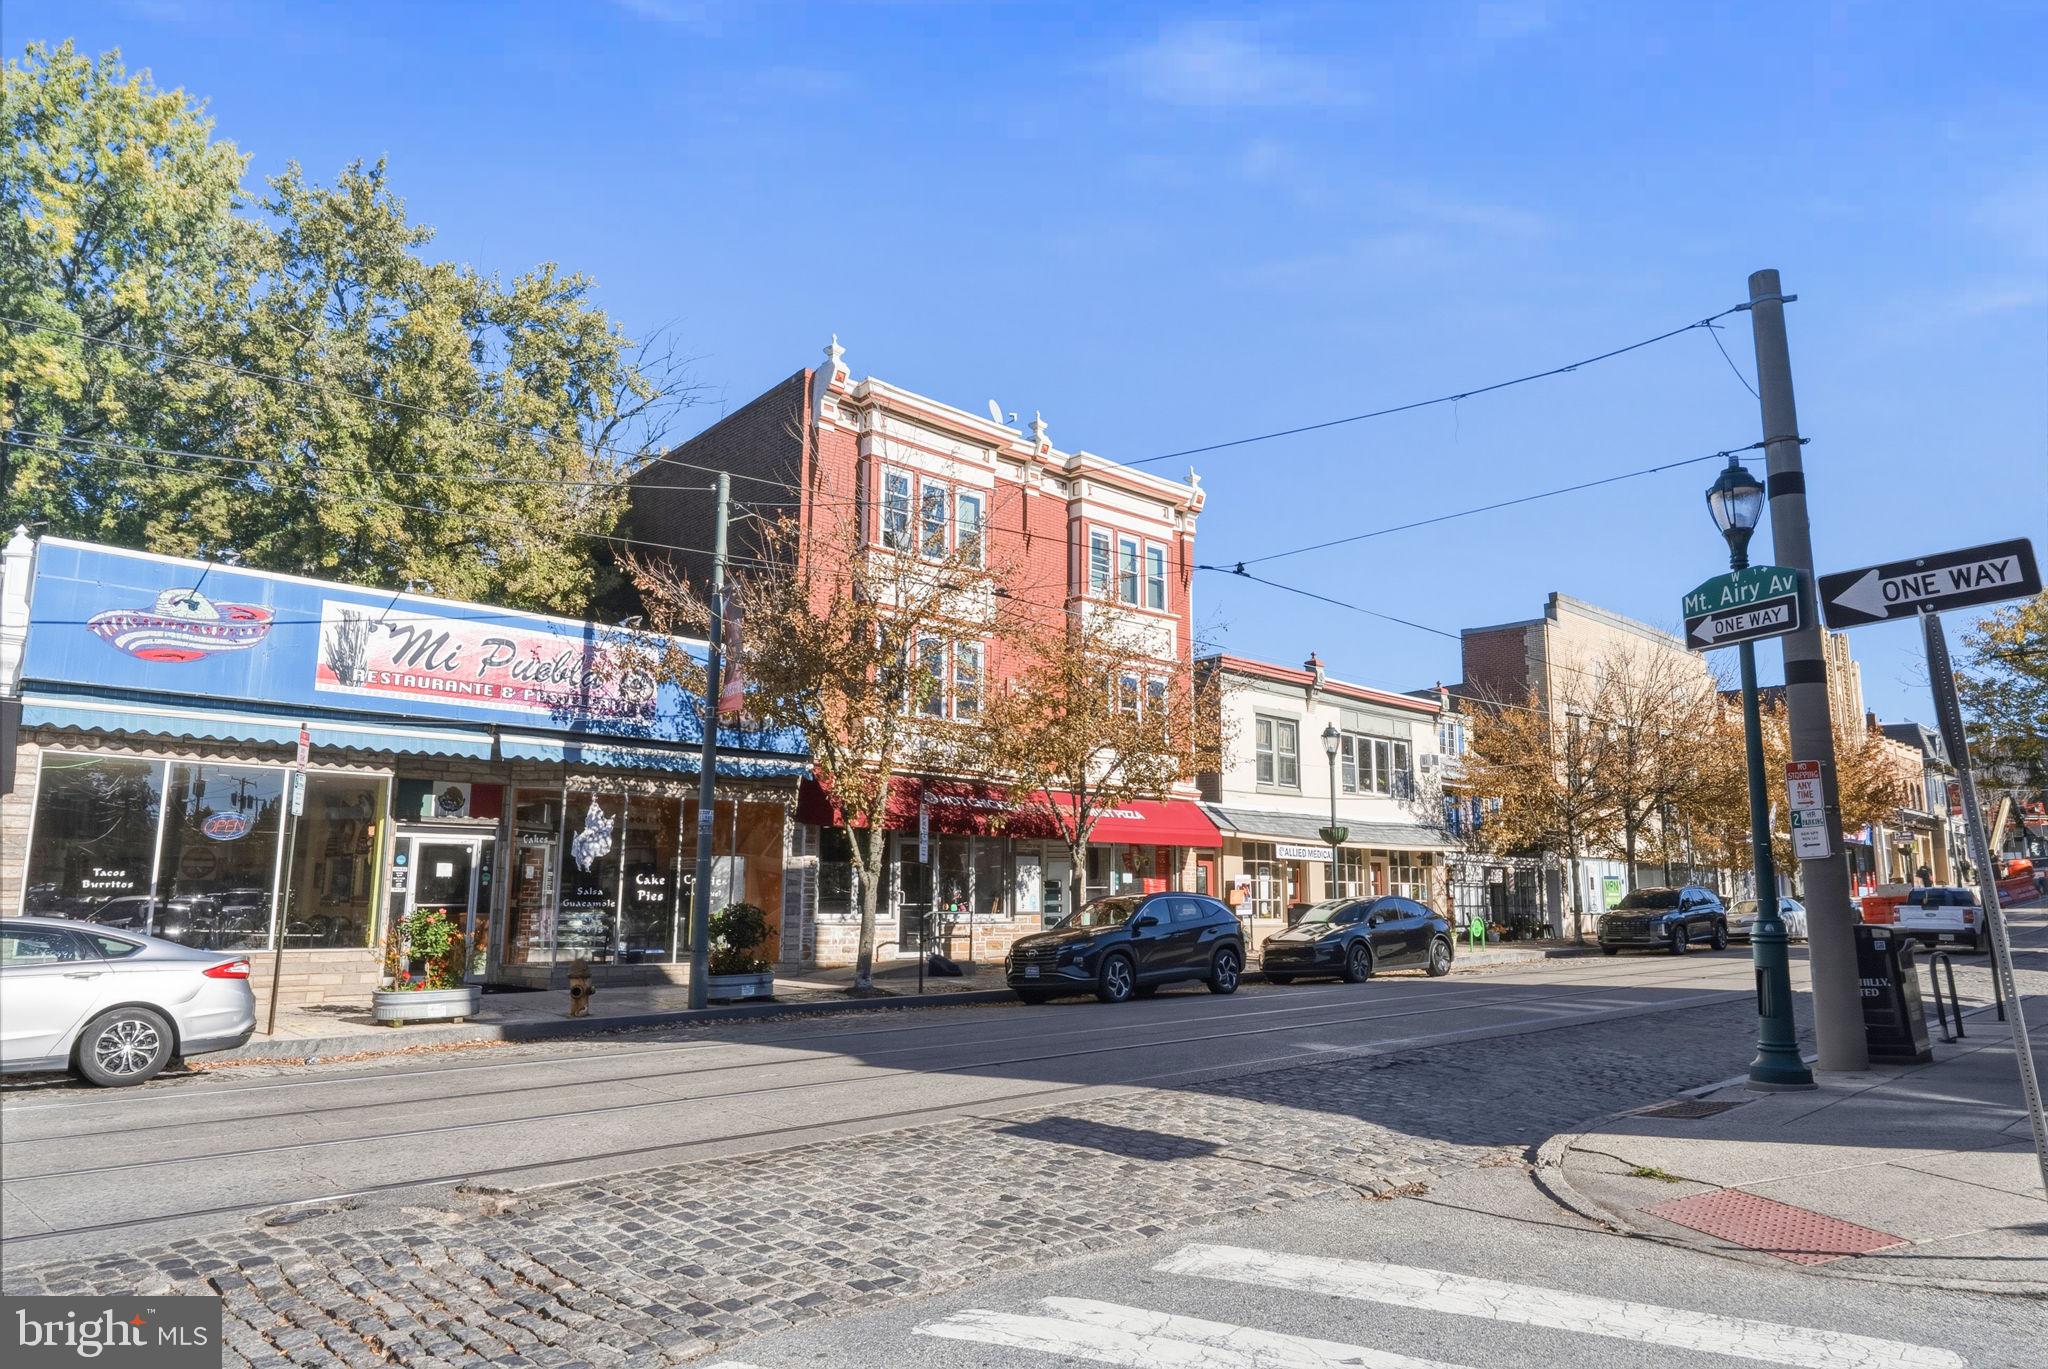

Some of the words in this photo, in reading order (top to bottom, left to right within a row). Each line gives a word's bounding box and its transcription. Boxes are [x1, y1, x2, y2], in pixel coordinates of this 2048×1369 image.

[1731, 572, 1740, 582] W
[1882, 573, 1940, 602] ONE
[1948, 559, 2010, 589] WAY
[1684, 593, 1712, 614] Mt.
[1720, 582, 1760, 606] Airy
[1769, 575, 1793, 594] Av
[1715, 616, 1744, 634] ONE
[1749, 608, 1782, 626] WAY
[390, 622, 463, 672] Mi
[481, 637, 603, 689] Puebla
[353, 669, 493, 697] RESTAURANTE
[501, 687, 516, 699] &
[1797, 763, 1807, 771] NO
[1787, 771, 1819, 780] STOPPING
[1797, 782, 1812, 790] ANY
[1797, 791, 1814, 799] TIME
[1113, 809, 1146, 820] PIZZA
[1792, 813, 1801, 826] 2
[203, 819, 246, 833] OPEN
[523, 834, 549, 844] Cakes
[1284, 848, 1307, 858] ALLIED
[92, 868, 126, 877] Tacos
[635, 873, 666, 885] Cake
[82, 880, 134, 889] Burritos
[576, 887, 604, 896] Salsa
[637, 890, 664, 901] Pies
[562, 899, 616, 908] Guacamole
